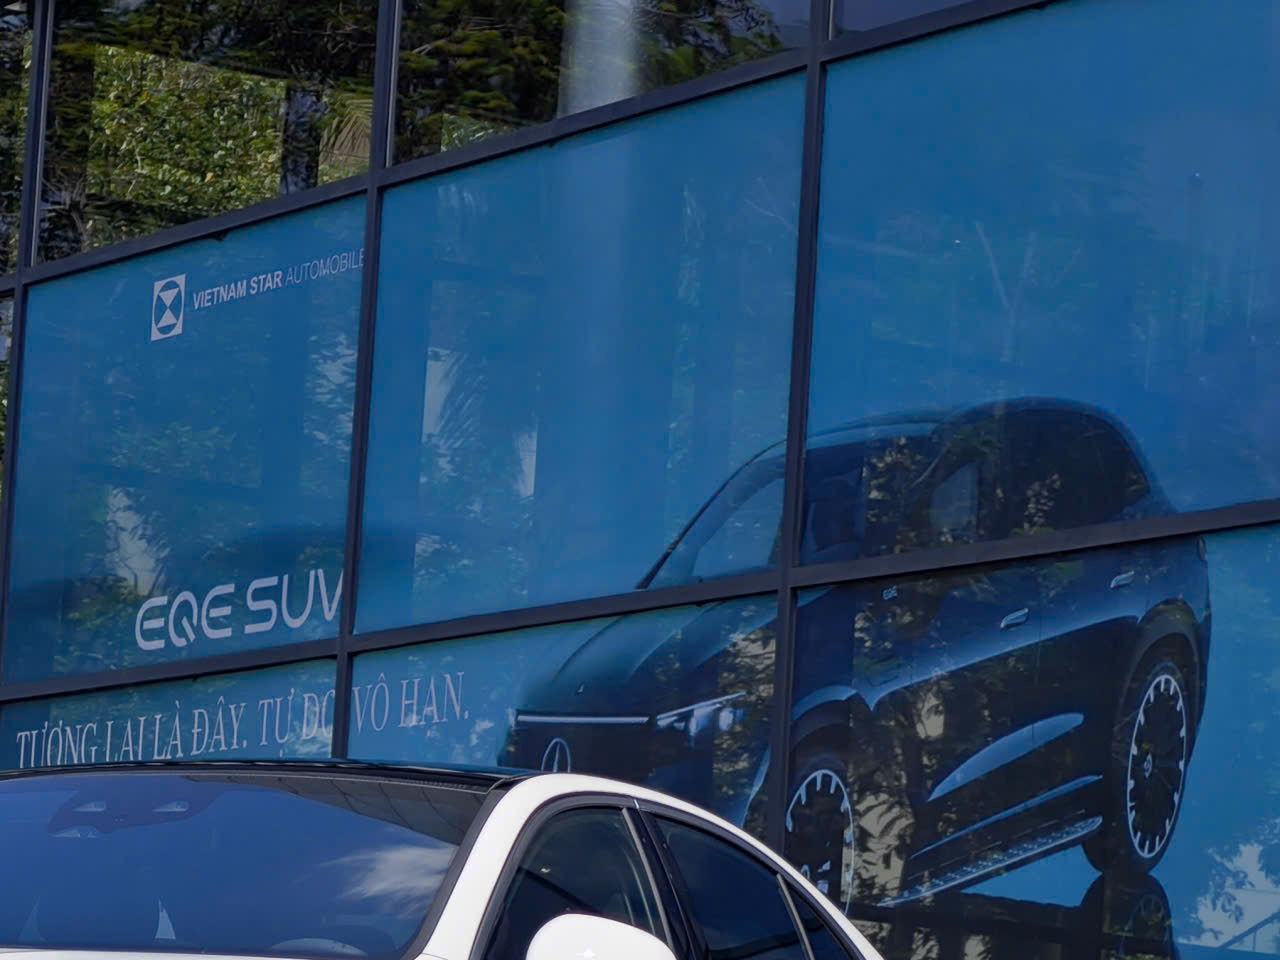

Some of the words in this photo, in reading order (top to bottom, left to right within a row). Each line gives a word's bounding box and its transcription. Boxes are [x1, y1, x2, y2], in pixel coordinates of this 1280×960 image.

[193, 279, 247, 310] VIETNAM
[249, 270, 283, 296] STAR
[285, 247, 364, 286] AUTOMOBILE
[135, 583, 236, 650] EQE
[243, 567, 343, 634] SUV
[153, 700, 184, 760] LÀ
[190, 695, 248, 756] ĐÂY.
[352, 671, 390, 736] VÔ
[397, 671, 470, 737] HẠN.
